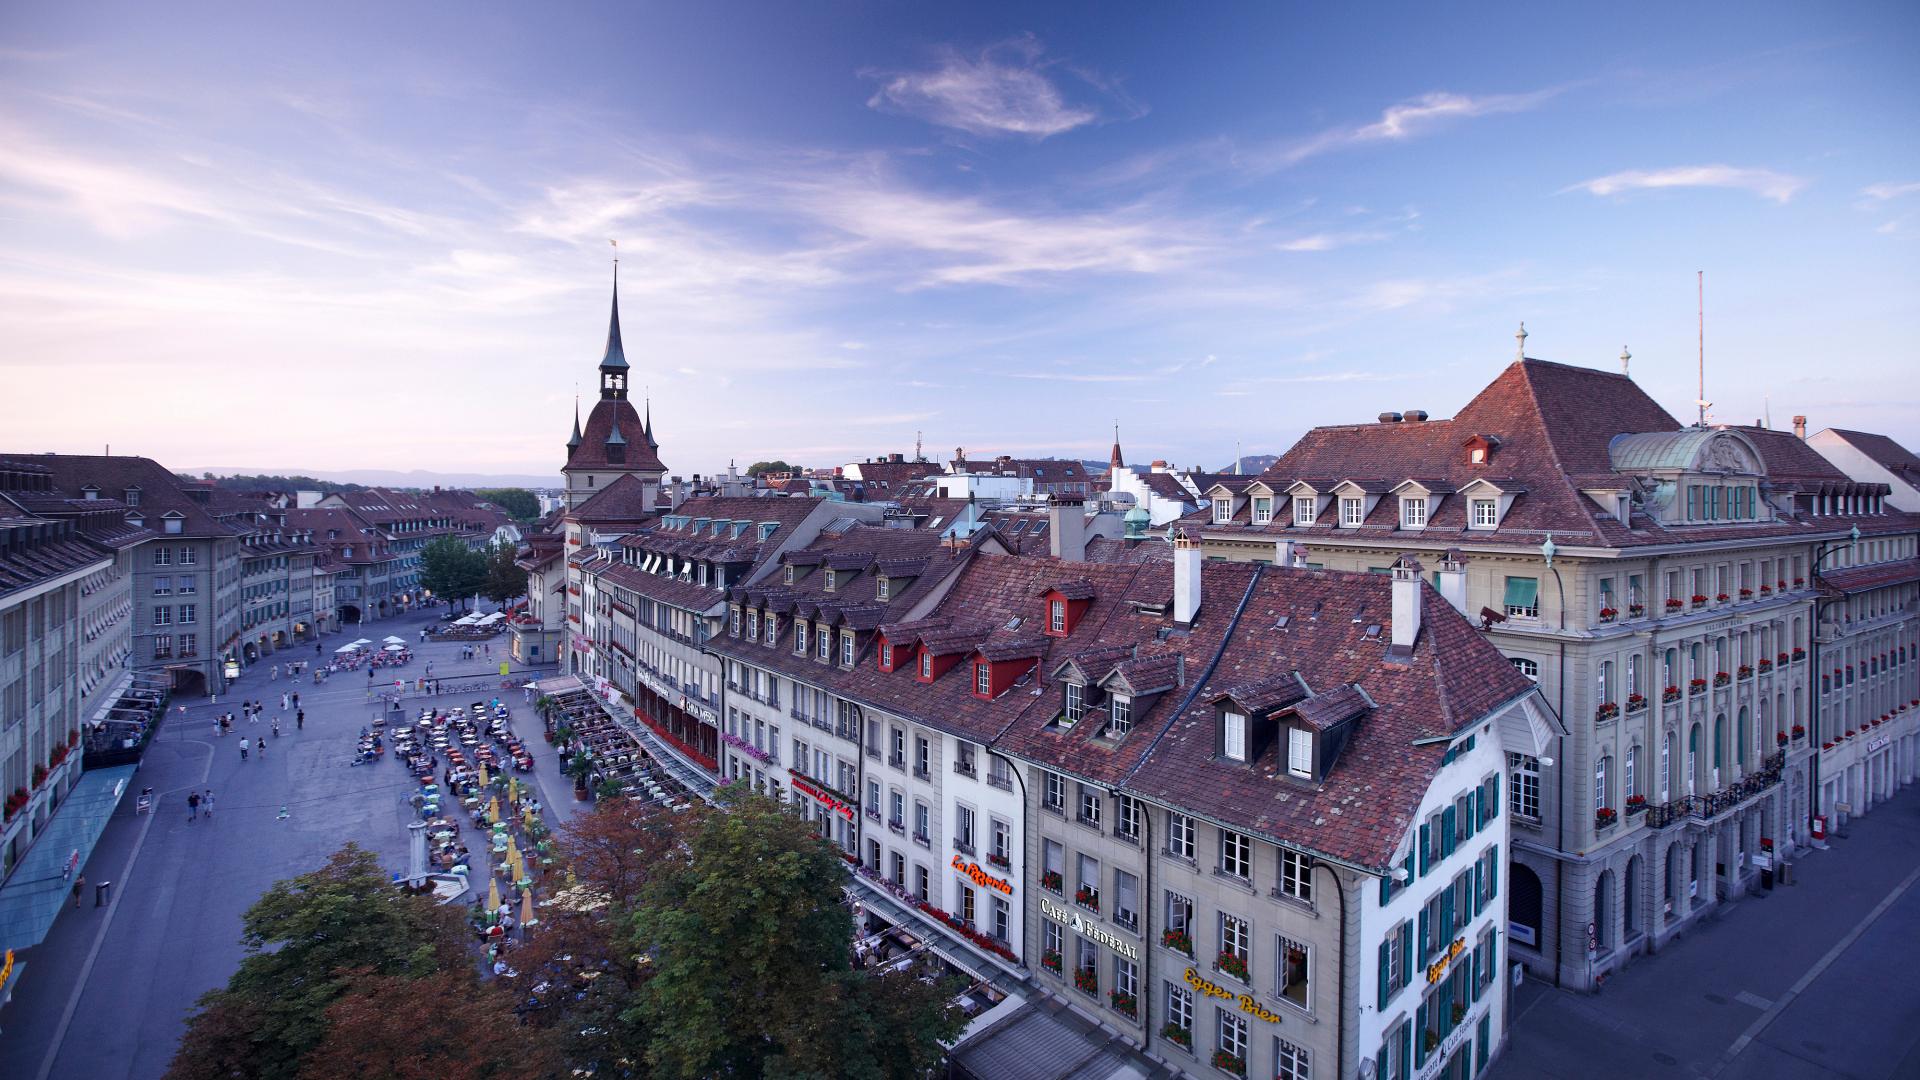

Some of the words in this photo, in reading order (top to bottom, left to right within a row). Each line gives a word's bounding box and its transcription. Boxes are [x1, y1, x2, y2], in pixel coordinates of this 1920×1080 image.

[951, 854, 966, 872] La
[965, 863, 1013, 895] Pizzeria
[1184, 967, 1234, 1000] Egger
[1238, 994, 1282, 1023] Bier
